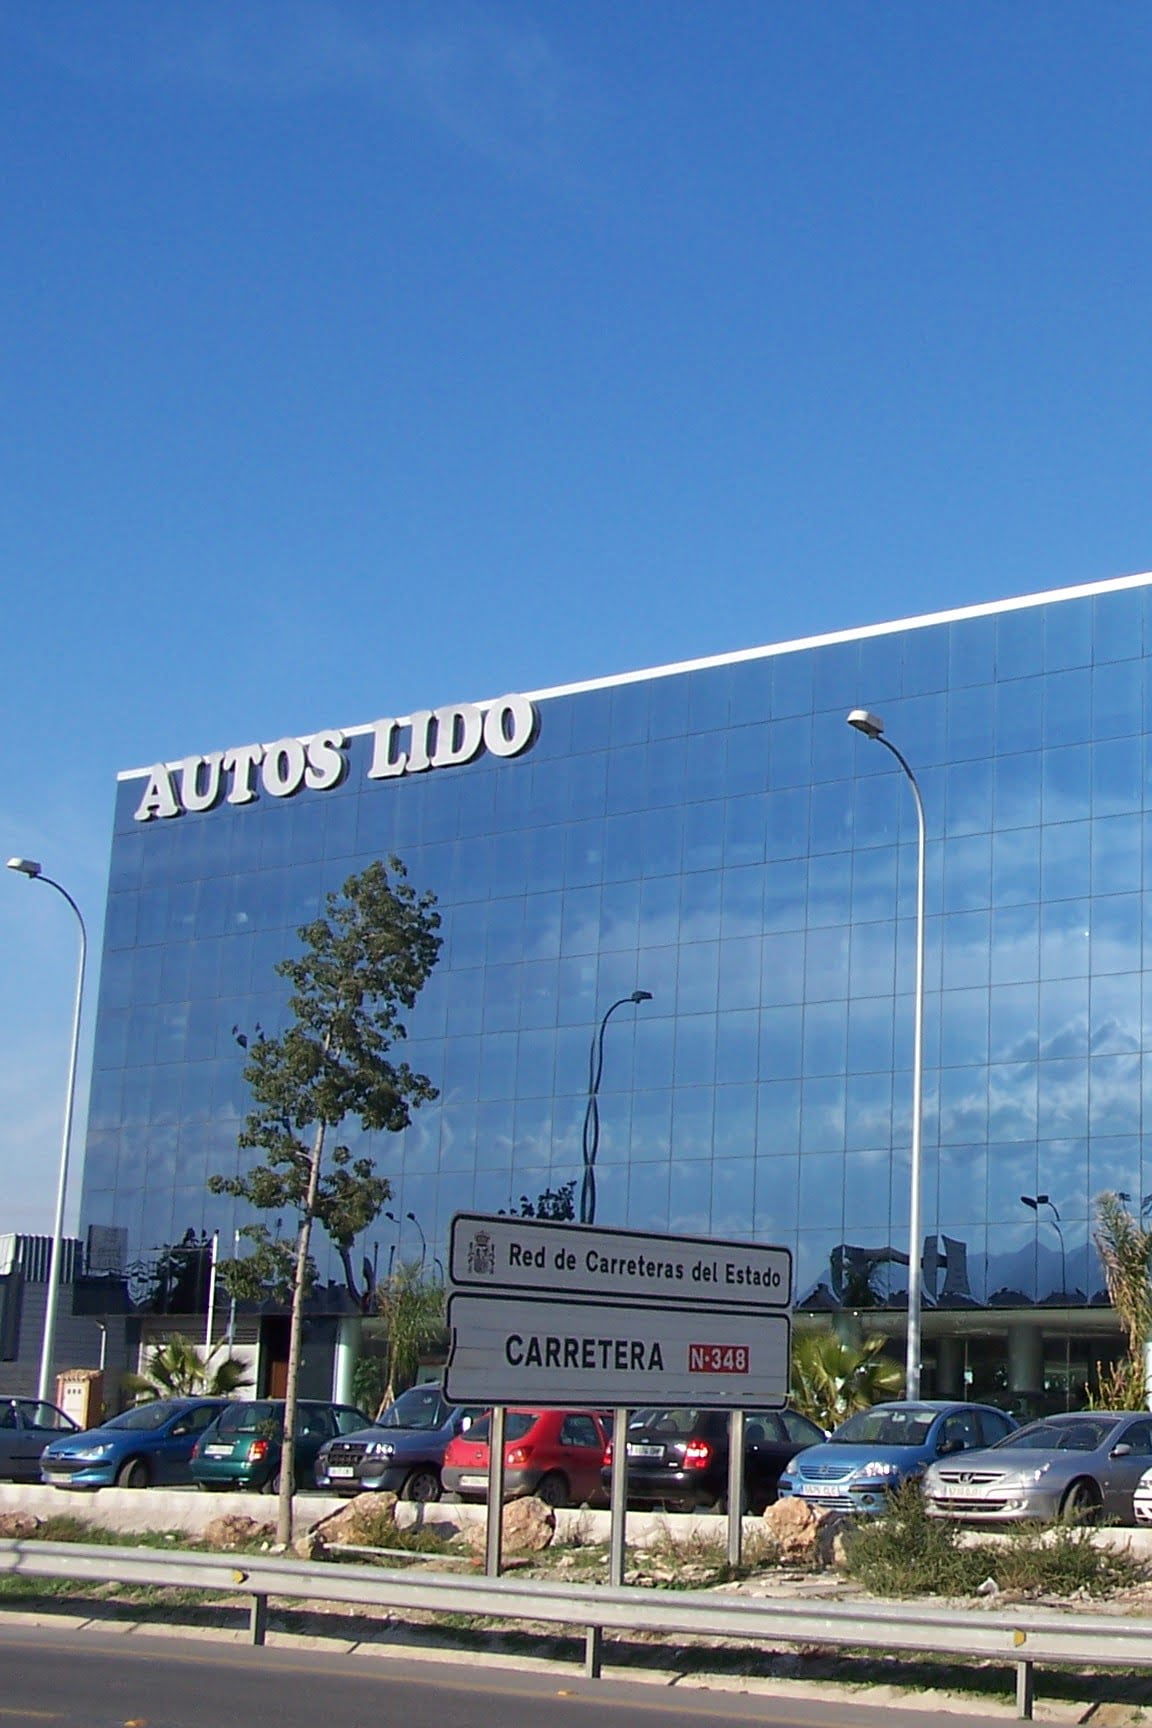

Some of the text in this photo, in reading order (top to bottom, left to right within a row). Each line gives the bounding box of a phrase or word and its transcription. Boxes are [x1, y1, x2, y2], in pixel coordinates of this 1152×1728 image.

[134, 692, 539, 822] AUTOS LIDO
[508, 1243, 781, 1288] Red de Carreteras del Estado
[505, 1334, 664, 1371] CARRETERA
